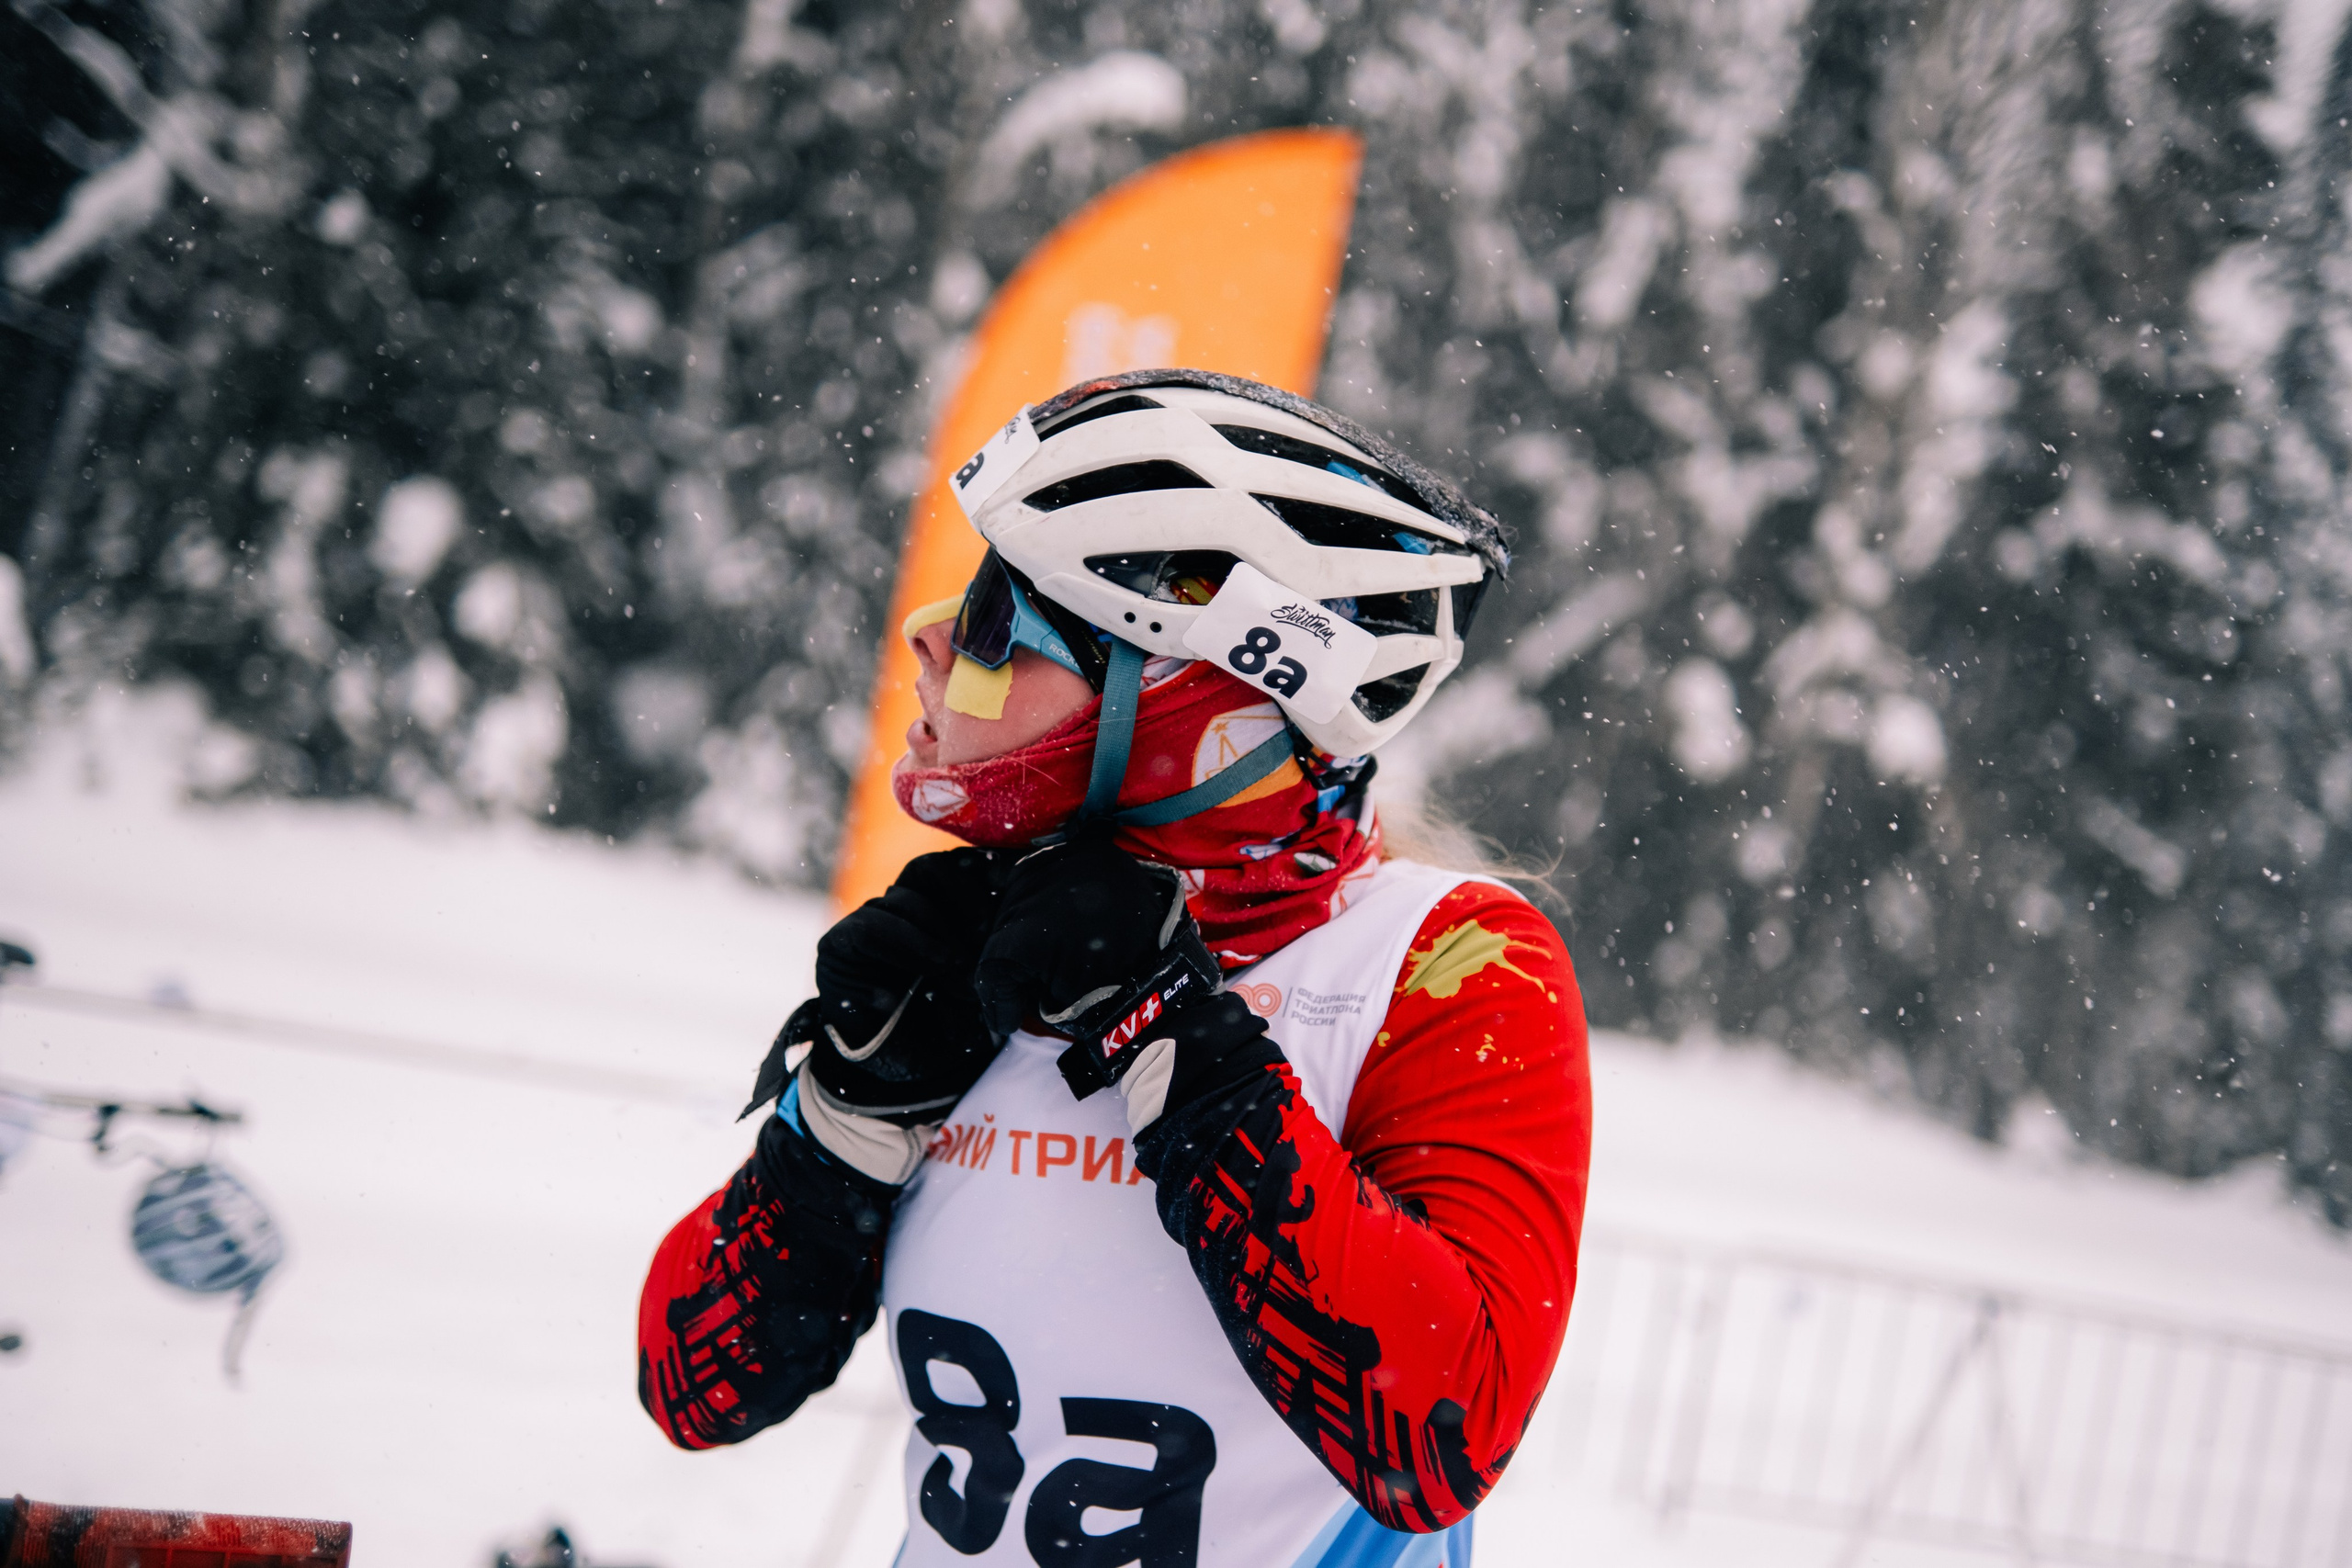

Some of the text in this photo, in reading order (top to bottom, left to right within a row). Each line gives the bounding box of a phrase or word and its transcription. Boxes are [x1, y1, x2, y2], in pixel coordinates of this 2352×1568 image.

[1227, 626, 1307, 699] 8a
[1163, 973, 1190, 1000] ELITE
[1297, 987, 1366, 1005] ФЕДЕРАЦИЯ
[1295, 998, 1361, 1014] ТРИАТЛОНА
[1291, 1010, 1336, 1026] РОССИИ
[896, 1307, 1217, 1567] 8a
